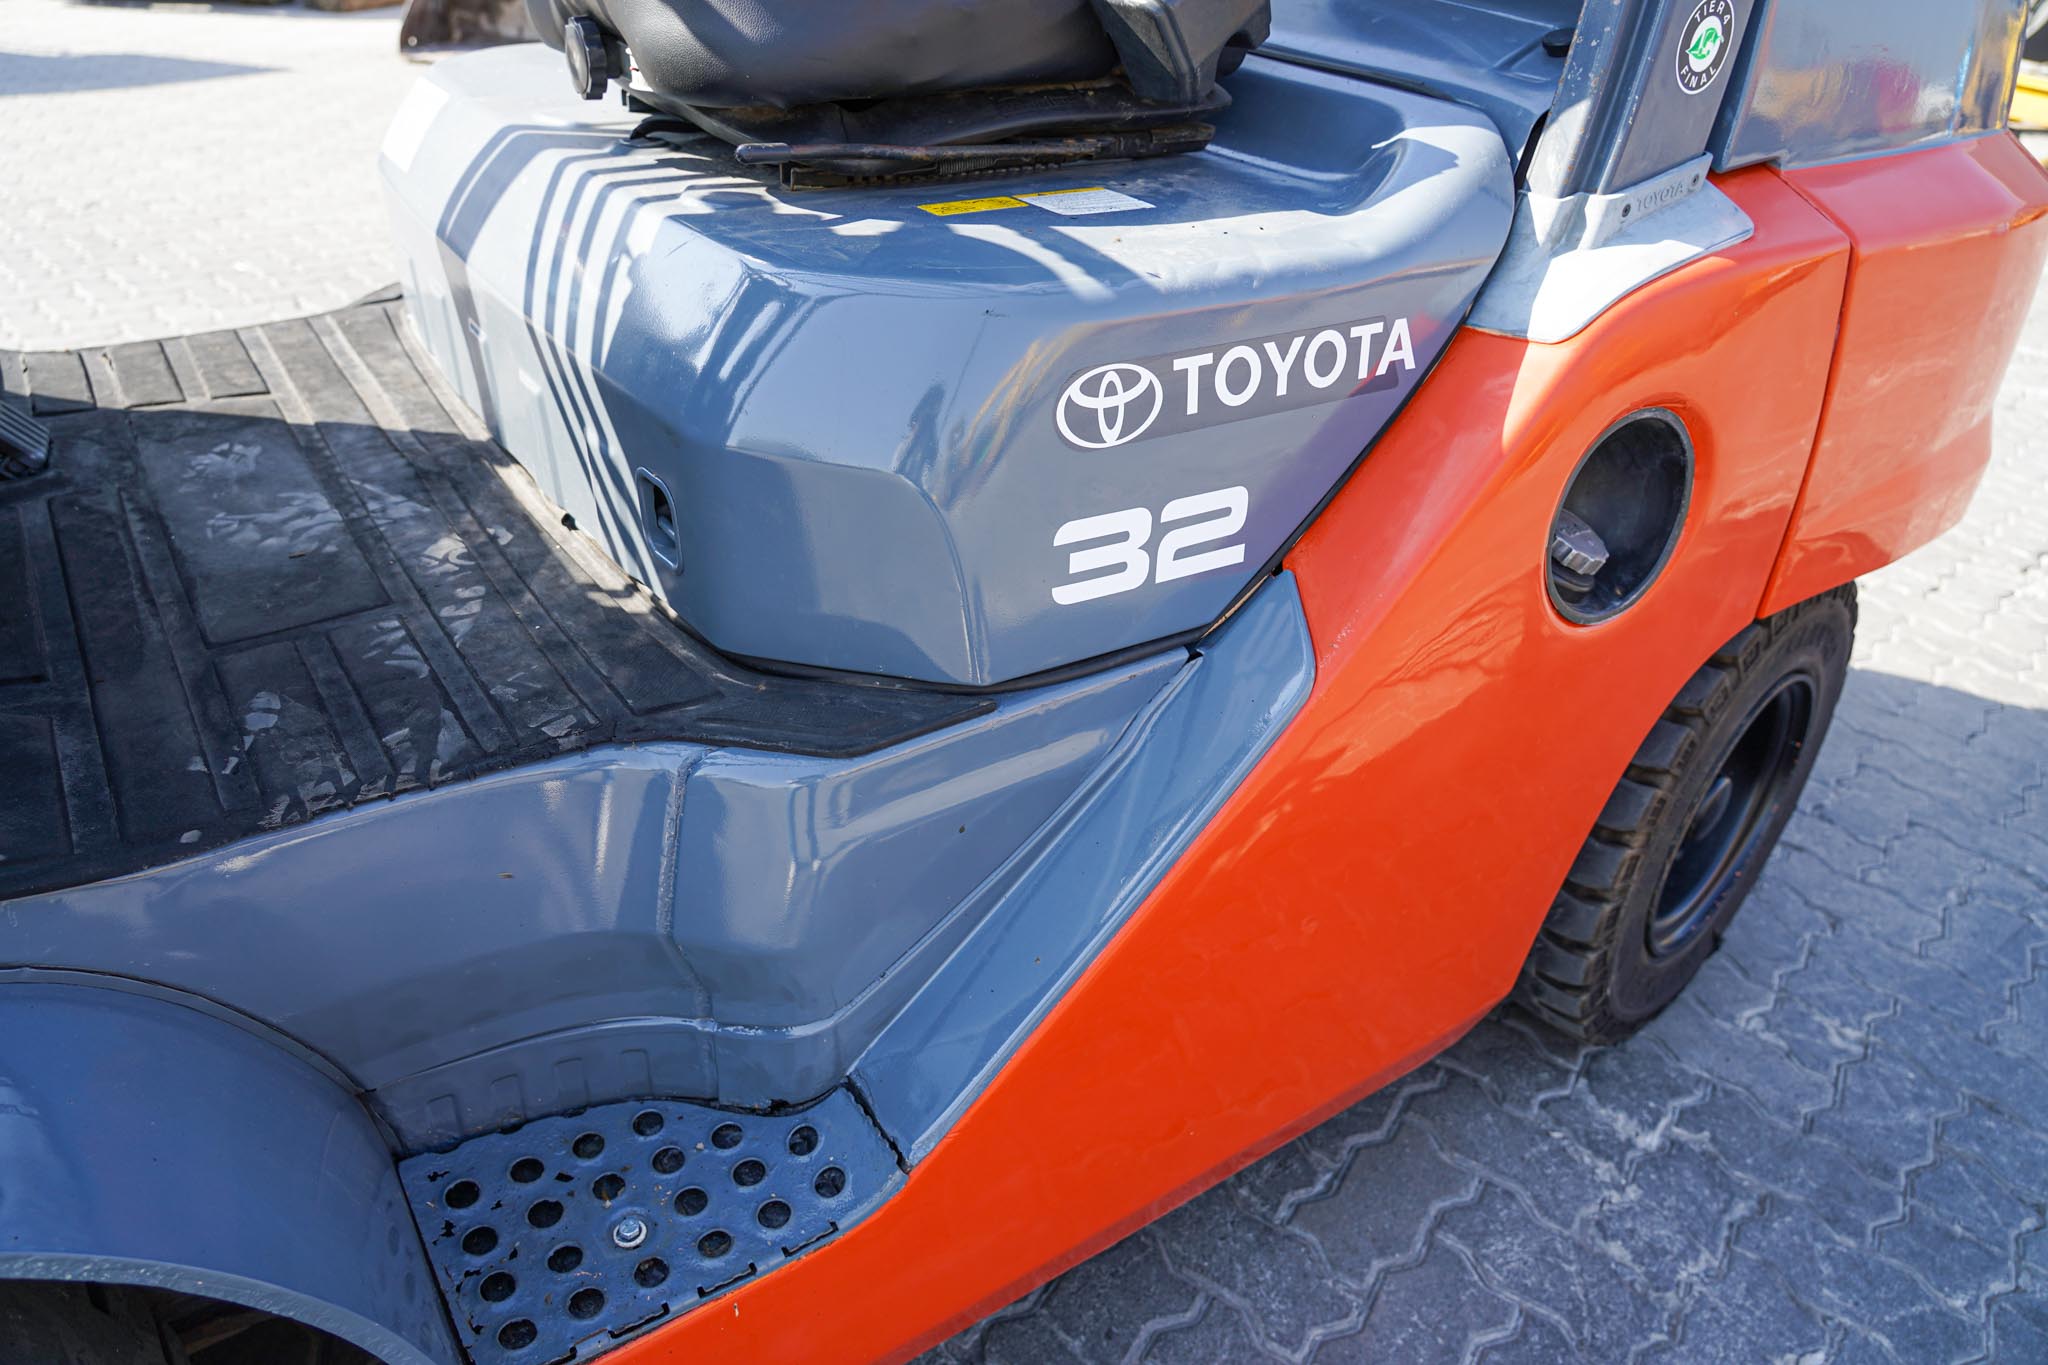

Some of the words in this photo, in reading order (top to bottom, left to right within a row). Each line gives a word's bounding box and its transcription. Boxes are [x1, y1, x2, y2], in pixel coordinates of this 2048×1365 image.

[1680, 65, 1716, 88] FINAL
[1636, 181, 1684, 212] TOYOTA
[1172, 317, 1416, 416] TOYOTA
[1051, 485, 1250, 606] 32
